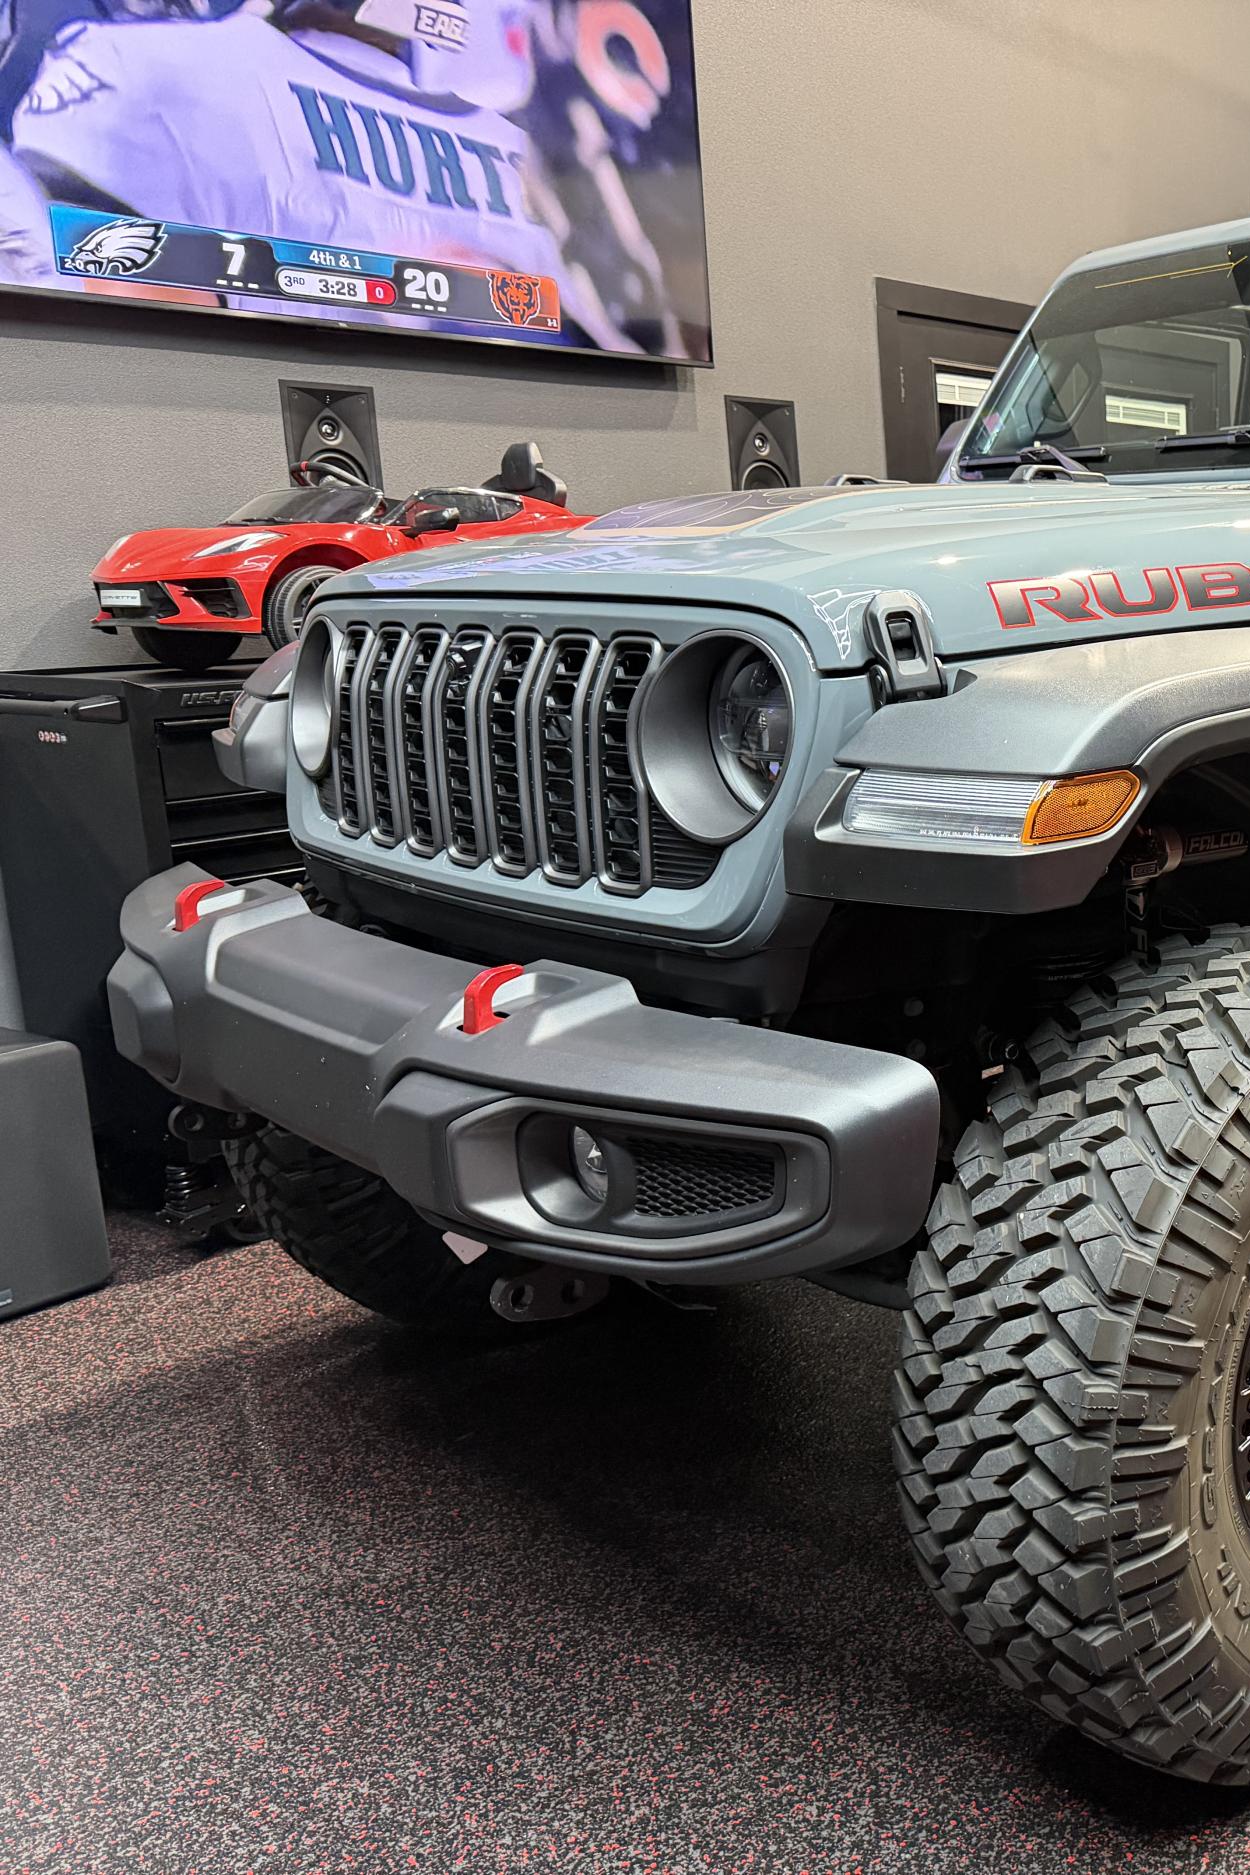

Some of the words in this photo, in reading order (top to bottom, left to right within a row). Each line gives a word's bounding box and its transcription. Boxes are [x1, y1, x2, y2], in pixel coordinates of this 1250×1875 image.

[64, 257, 85, 270] 2-0
[222, 243, 246, 276] 7
[309, 249, 336, 268] 4th
[339, 254, 352, 269] &
[353, 256, 362, 272] 1
[283, 275, 306, 287] 3RD
[318, 277, 358, 298] 3:28
[375, 285, 385, 300] 0
[403, 268, 450, 302] 20
